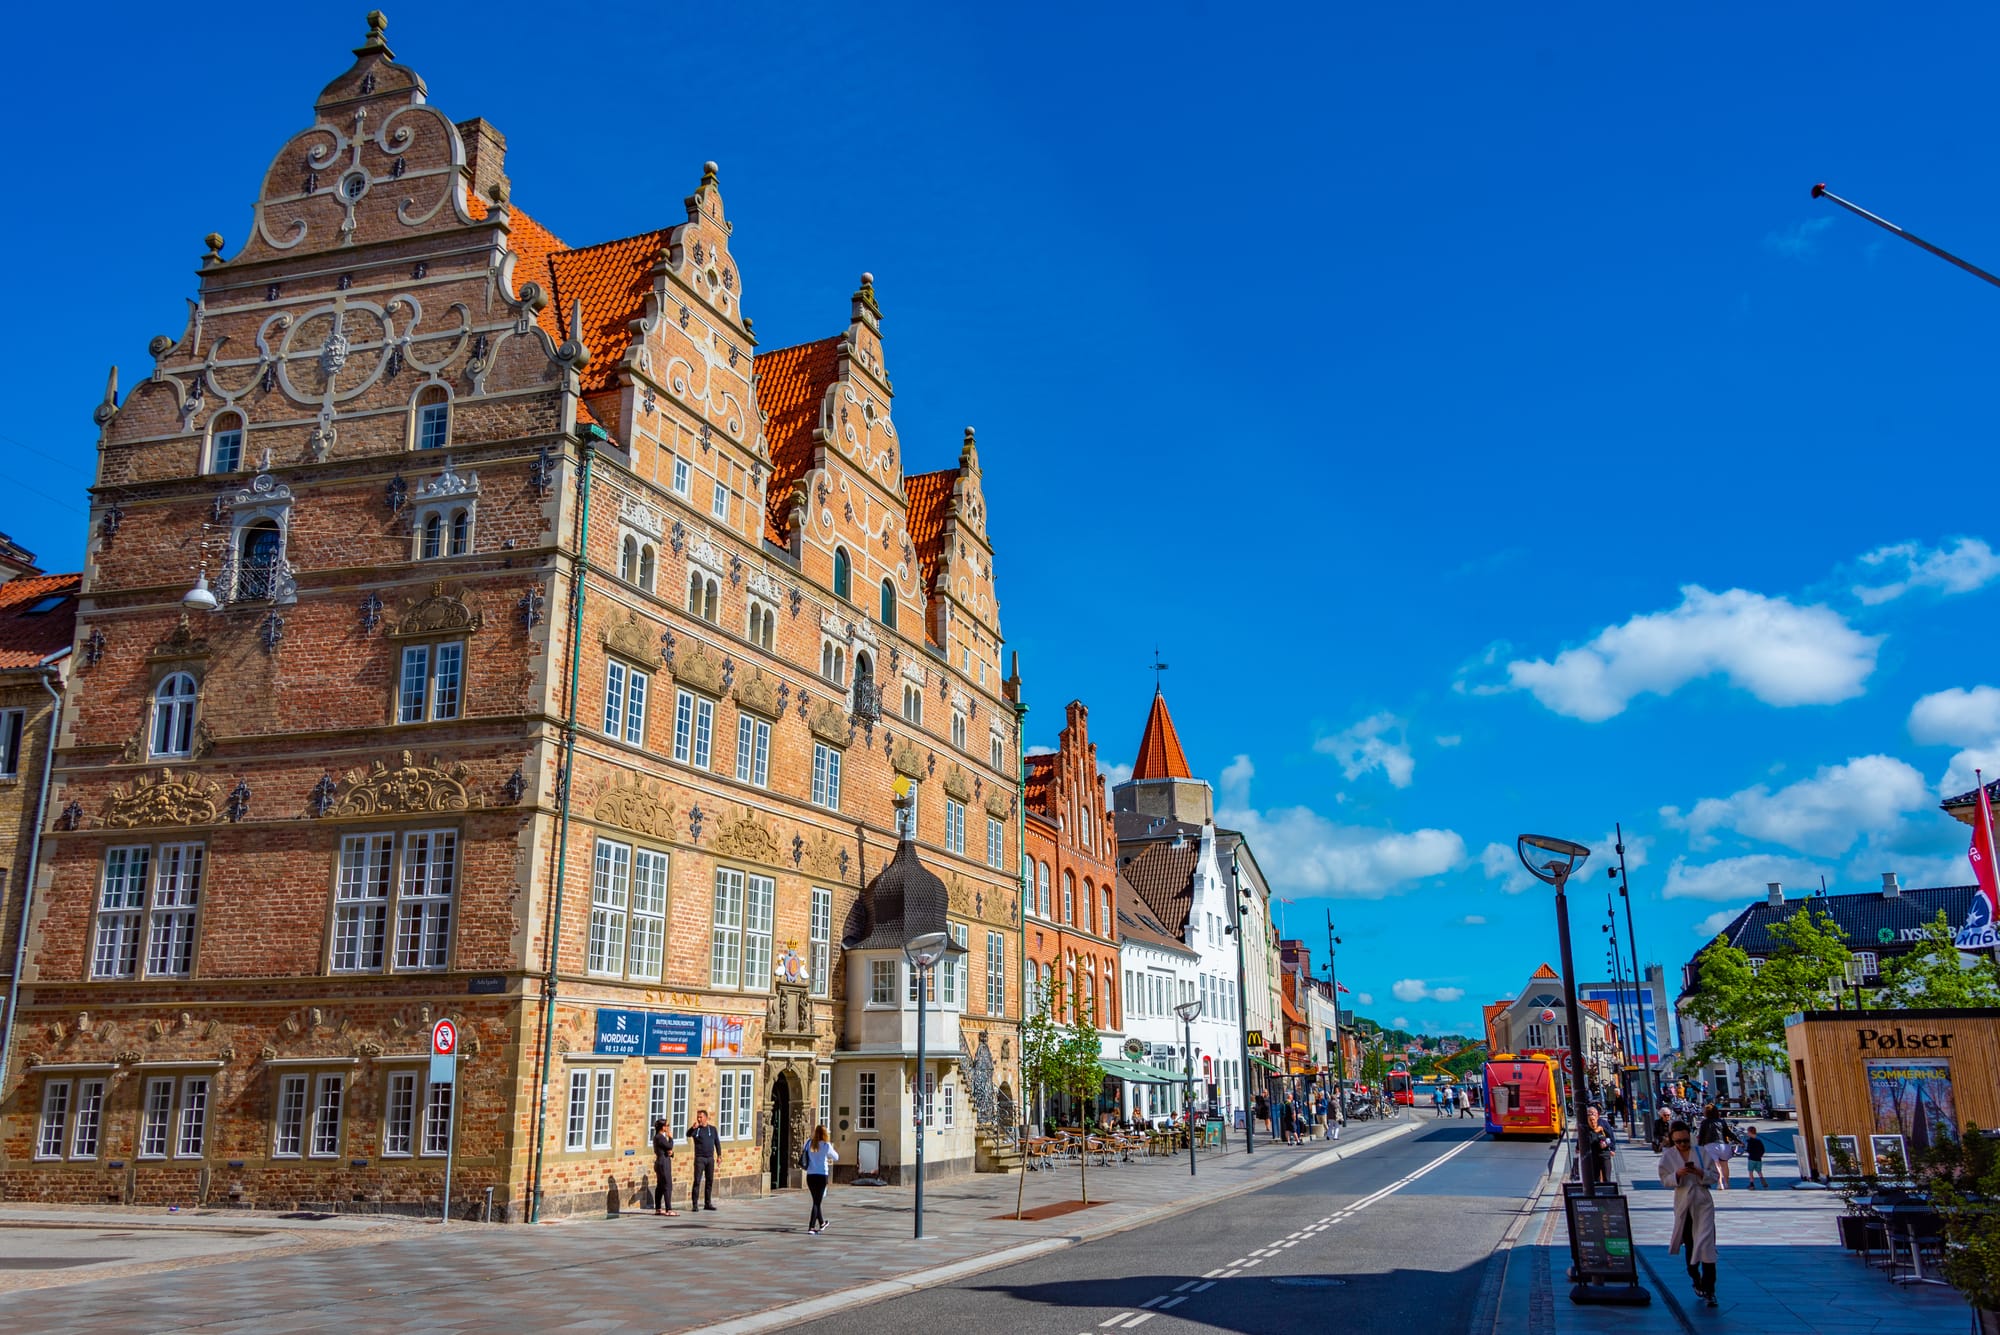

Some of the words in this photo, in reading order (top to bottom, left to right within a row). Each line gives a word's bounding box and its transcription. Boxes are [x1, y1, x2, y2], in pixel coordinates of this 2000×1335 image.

[645, 989, 702, 1007] SVANE
[601, 1033, 639, 1044] NORDICALS
[1856, 1028, 1953, 1049] Pølser
[1870, 1069, 1947, 1080] SOMMERHUS
